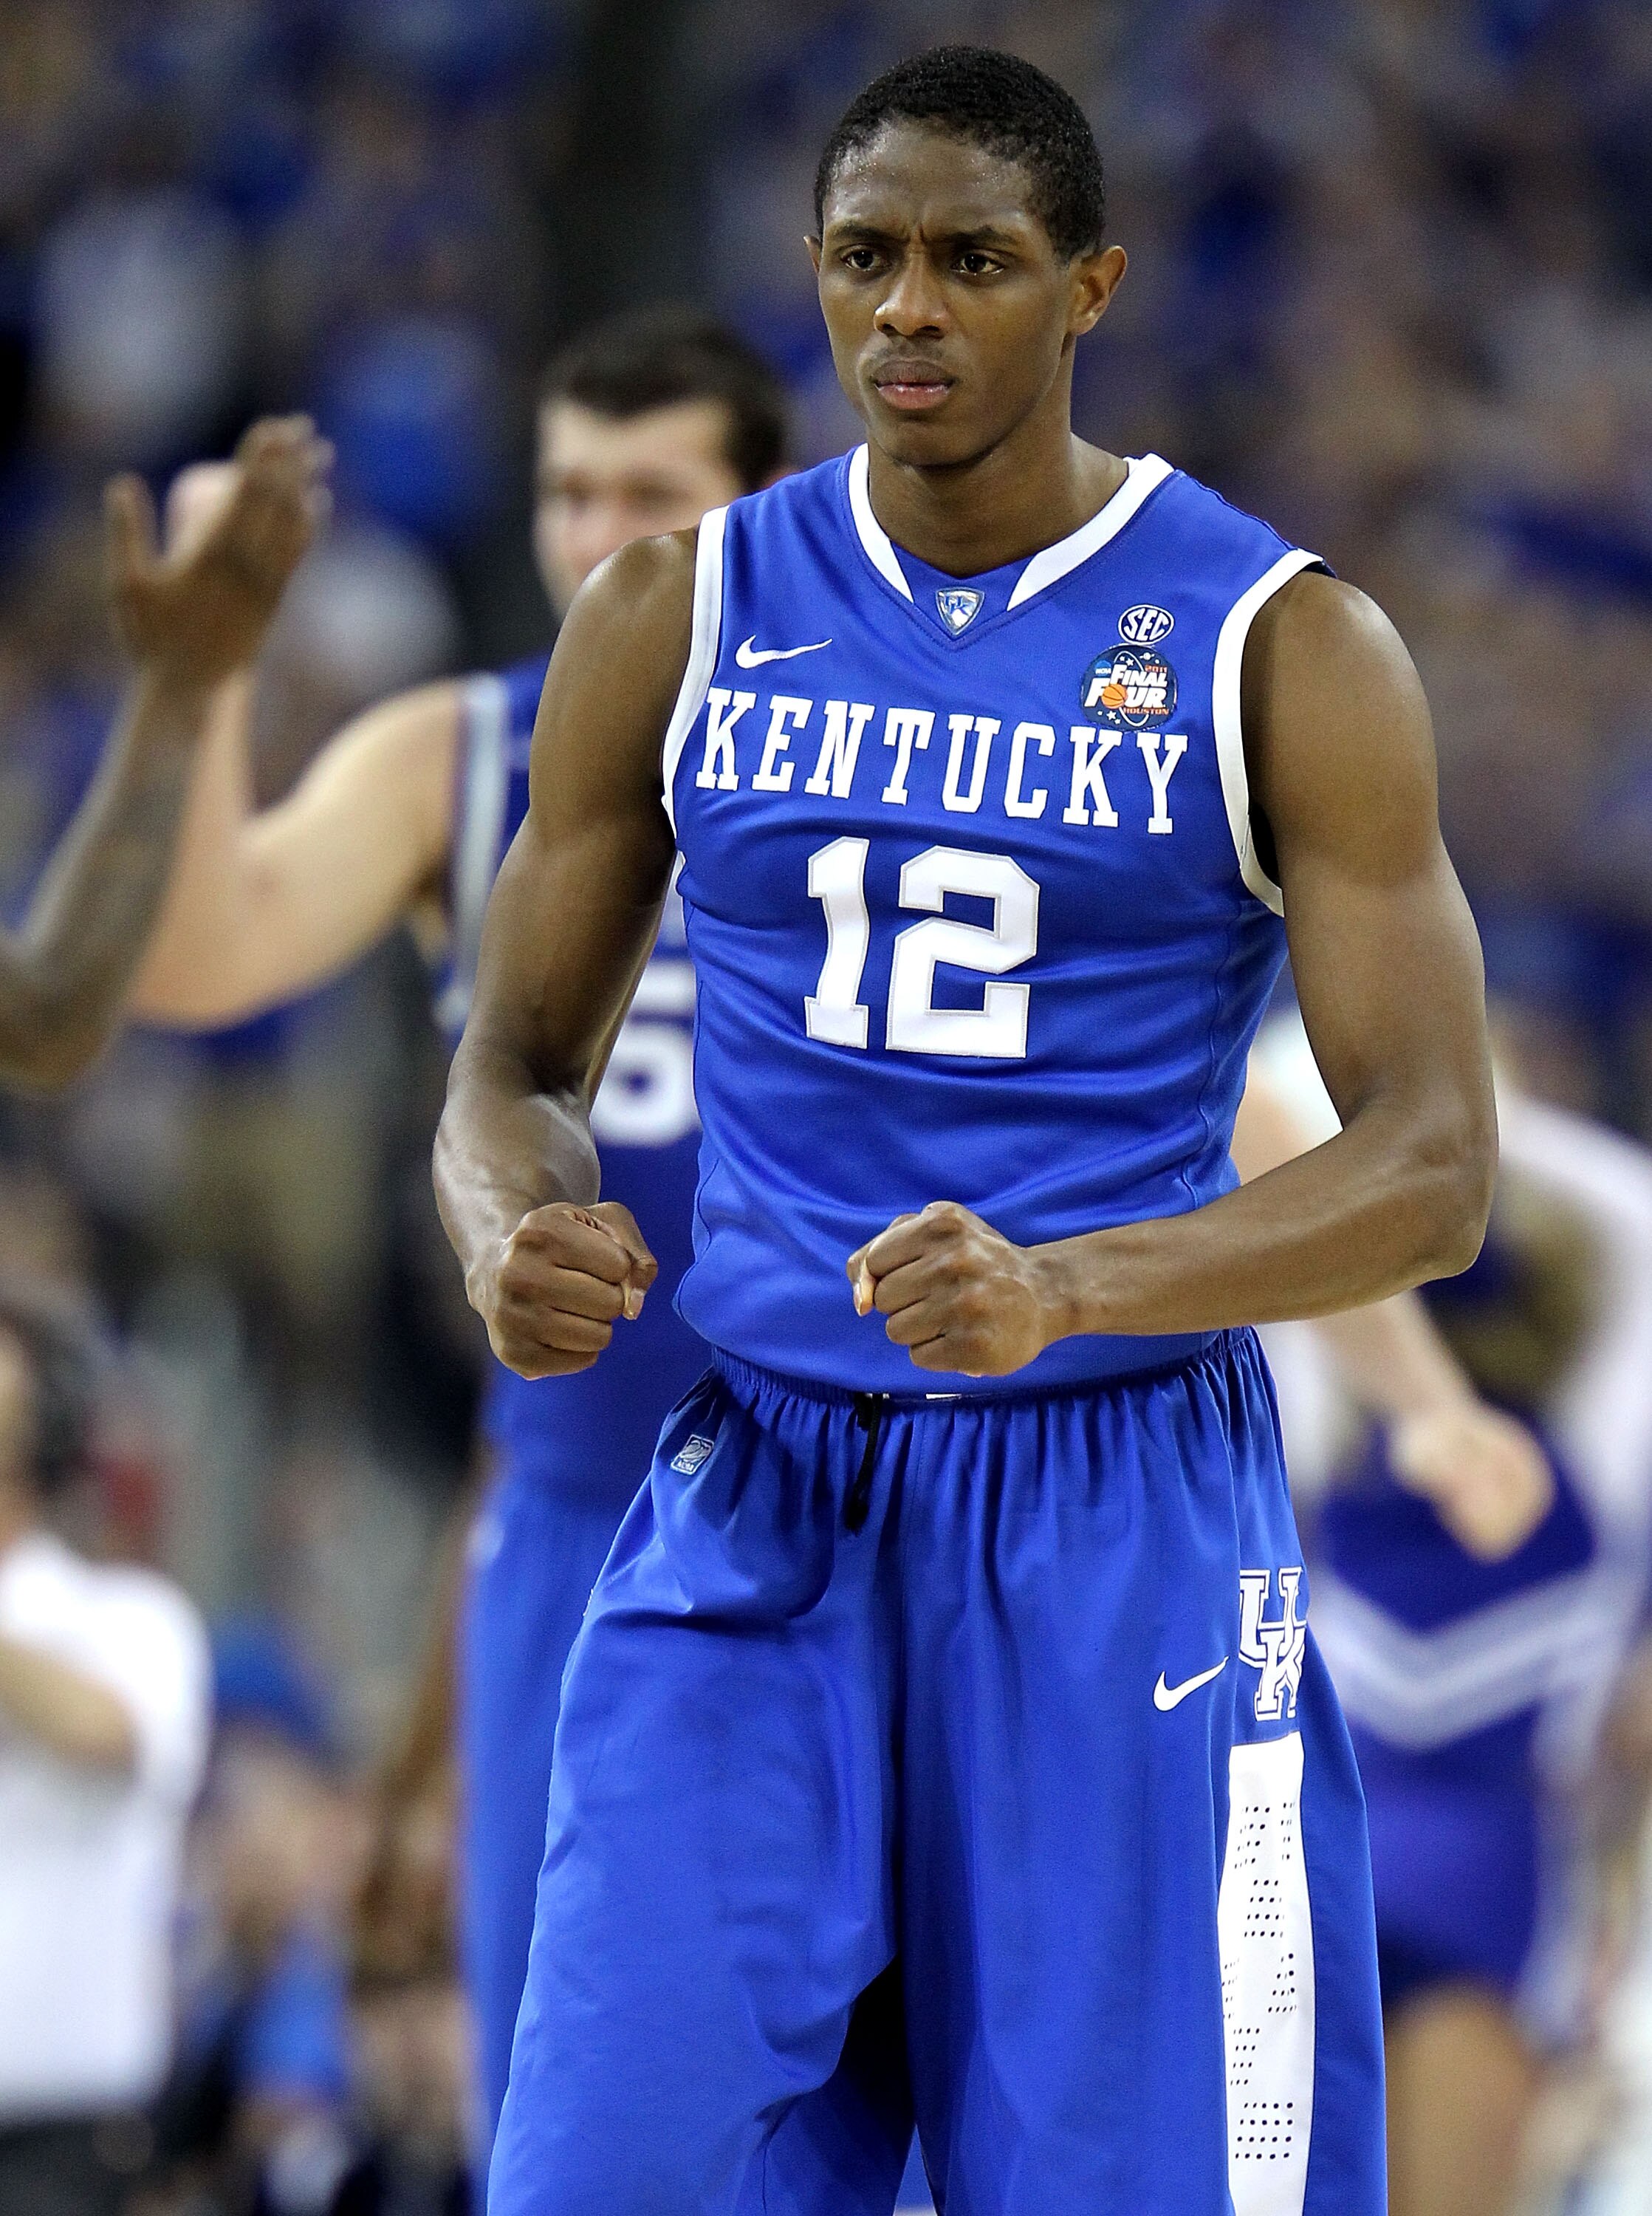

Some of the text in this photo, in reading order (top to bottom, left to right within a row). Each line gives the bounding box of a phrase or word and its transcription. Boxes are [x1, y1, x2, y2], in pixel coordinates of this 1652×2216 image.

[1123, 607, 1170, 641] SEC
[1111, 664, 1168, 687] FINAL
[1145, 665, 1168, 674] 2011
[1123, 707, 1169, 715] HOUSTON
[696, 688, 1188, 834] KENTUCKY
[804, 836, 1040, 1059] 12
